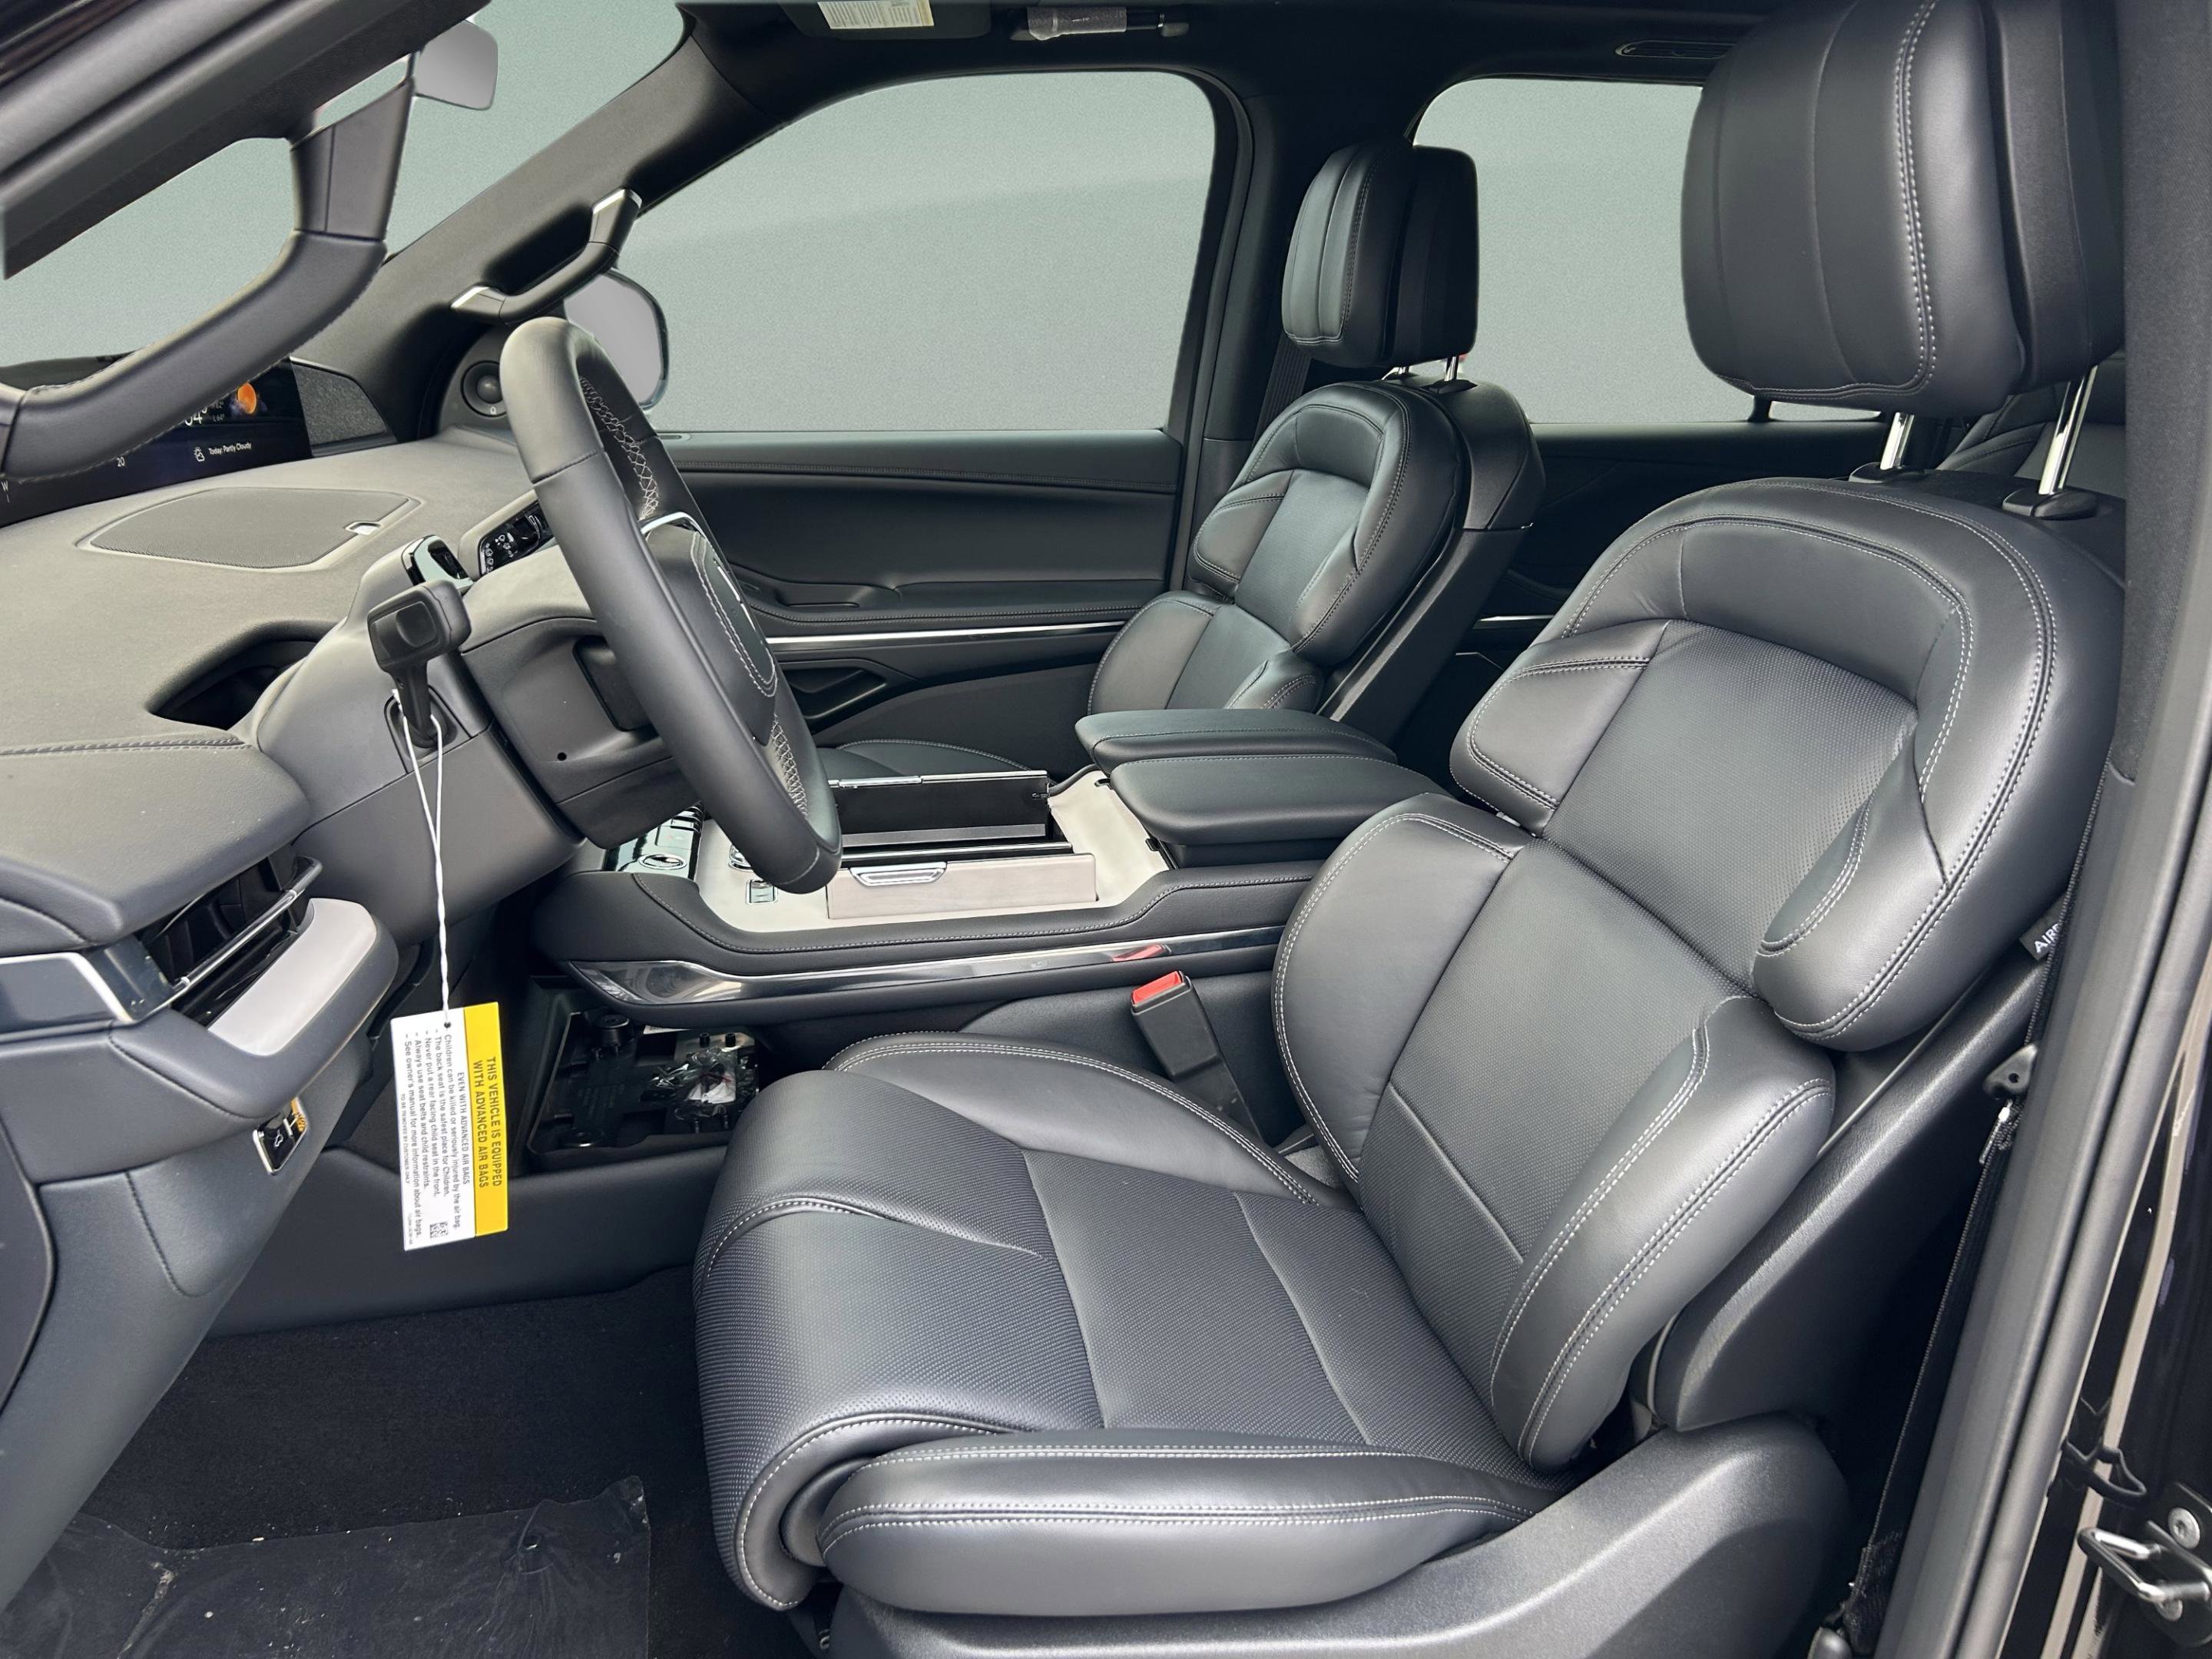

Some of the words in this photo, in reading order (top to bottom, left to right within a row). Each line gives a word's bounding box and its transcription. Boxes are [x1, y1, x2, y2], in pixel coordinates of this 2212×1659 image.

[236, 442, 252, 451] Cloudy
[116, 457, 125, 467] 20
[1, 480, 8, 492] W
[406, 1058, 415, 1088] owner's
[473, 1060, 484, 1087] WITH
[487, 1057, 497, 1081] THIS
[449, 1084, 455, 1094] be
[409, 1090, 417, 1116] manual
[488, 1083, 500, 1125] VEHICLE
[476, 1091, 487, 1142] ADVANCED
[431, 1124, 439, 1141] child
[451, 1127, 459, 1157] seriously
[492, 1130, 500, 1138] IS
[440, 1136, 449, 1154] place
[478, 1147, 488, 1161] AIR
[452, 1160, 460, 1182] injured
[492, 1141, 502, 1186] EQUIPPED
[479, 1164, 488, 1187] BAGS
[414, 1220, 422, 1237] bags.
[453, 1215, 462, 1229] bag.
